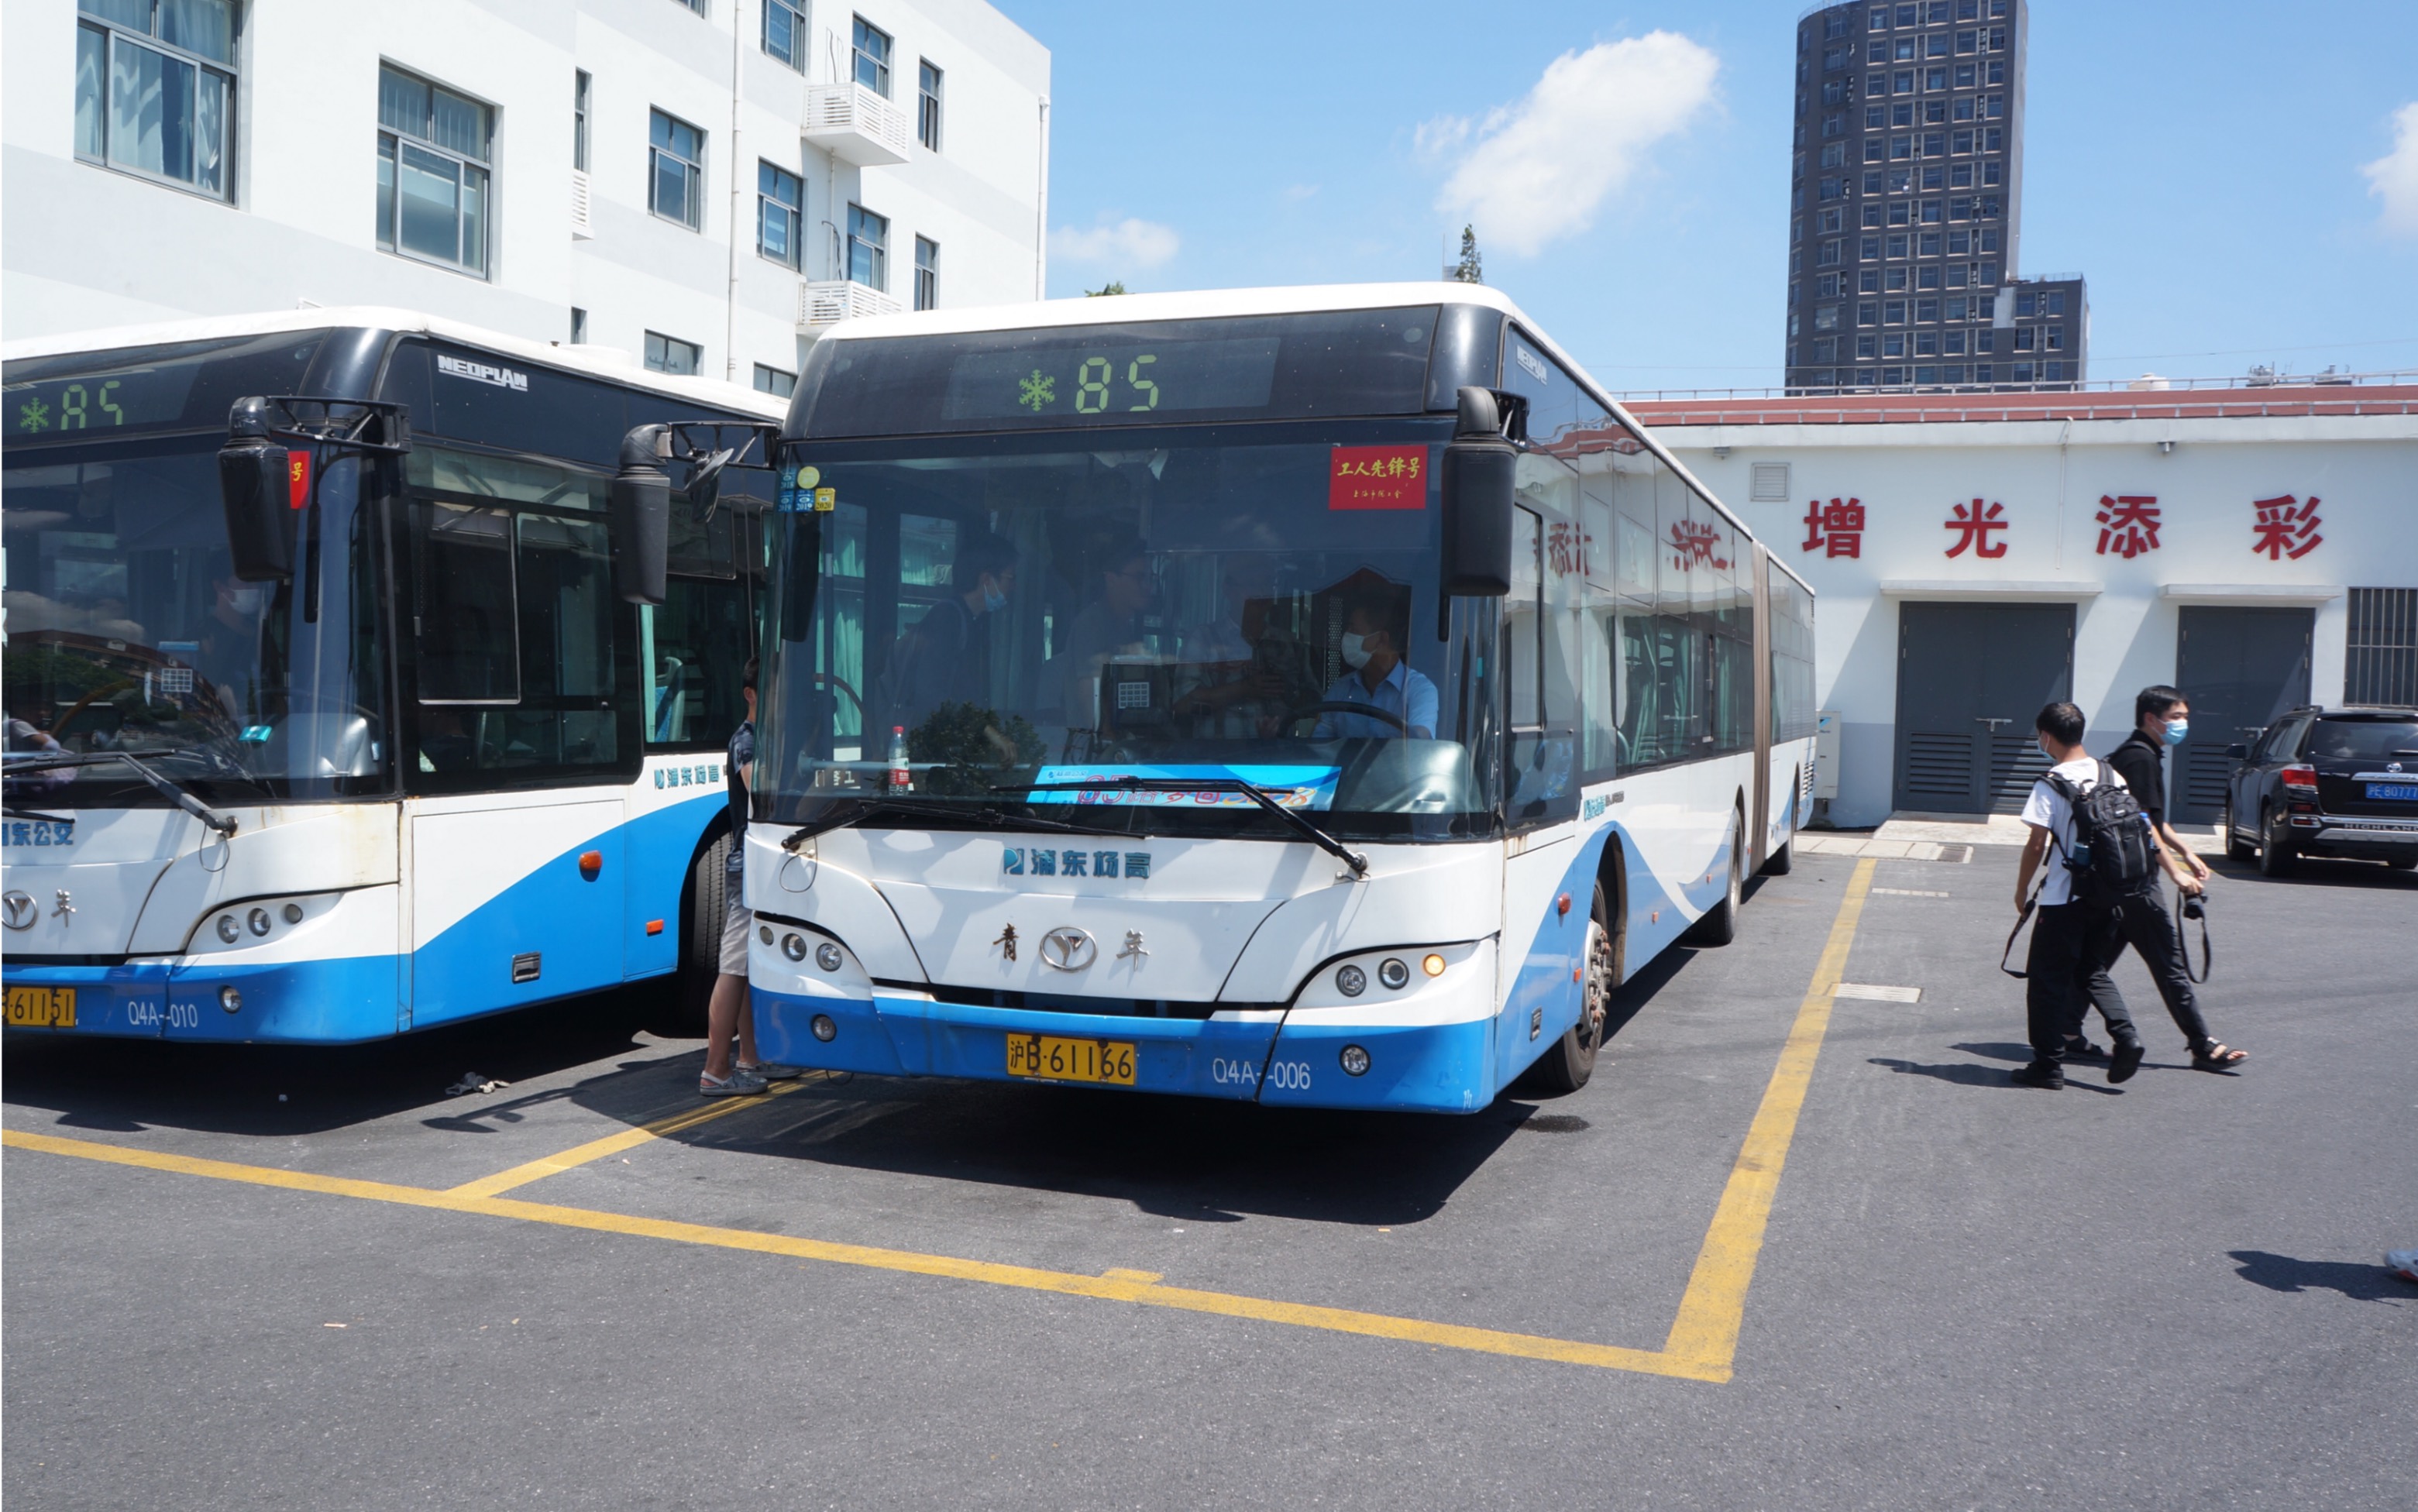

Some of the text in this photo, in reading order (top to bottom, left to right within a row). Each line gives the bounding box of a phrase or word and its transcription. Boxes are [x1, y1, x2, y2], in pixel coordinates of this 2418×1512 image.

[437, 354, 528, 392] NEOPLAN
[1075, 355, 1159, 414] 85
[1517, 345, 1547, 386] NEOPLAN
[291, 462, 303, 481] 号
[1801, 494, 2323, 560] 增光添彩
[1031, 849, 1152, 879] 浦东杨高
